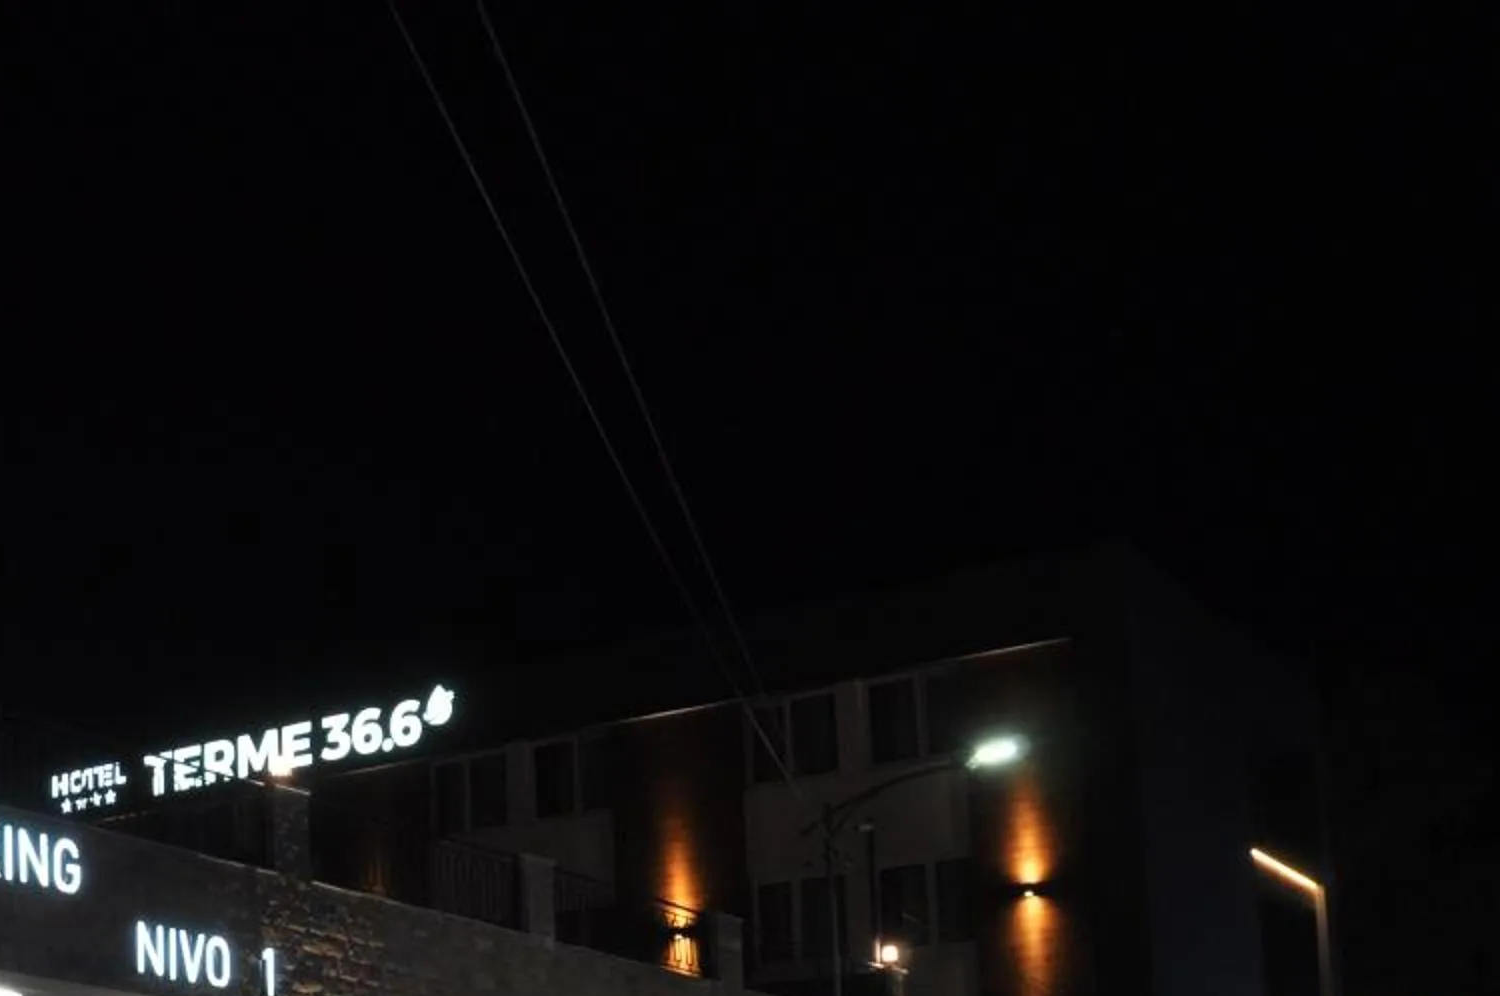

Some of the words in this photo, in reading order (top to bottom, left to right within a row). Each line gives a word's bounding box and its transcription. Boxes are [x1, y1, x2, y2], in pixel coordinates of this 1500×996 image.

[51, 762, 127, 799] HOTEL
[143, 721, 314, 796] TERME
[320, 699, 424, 761] 36.6
[134, 920, 232, 989] NIVO
